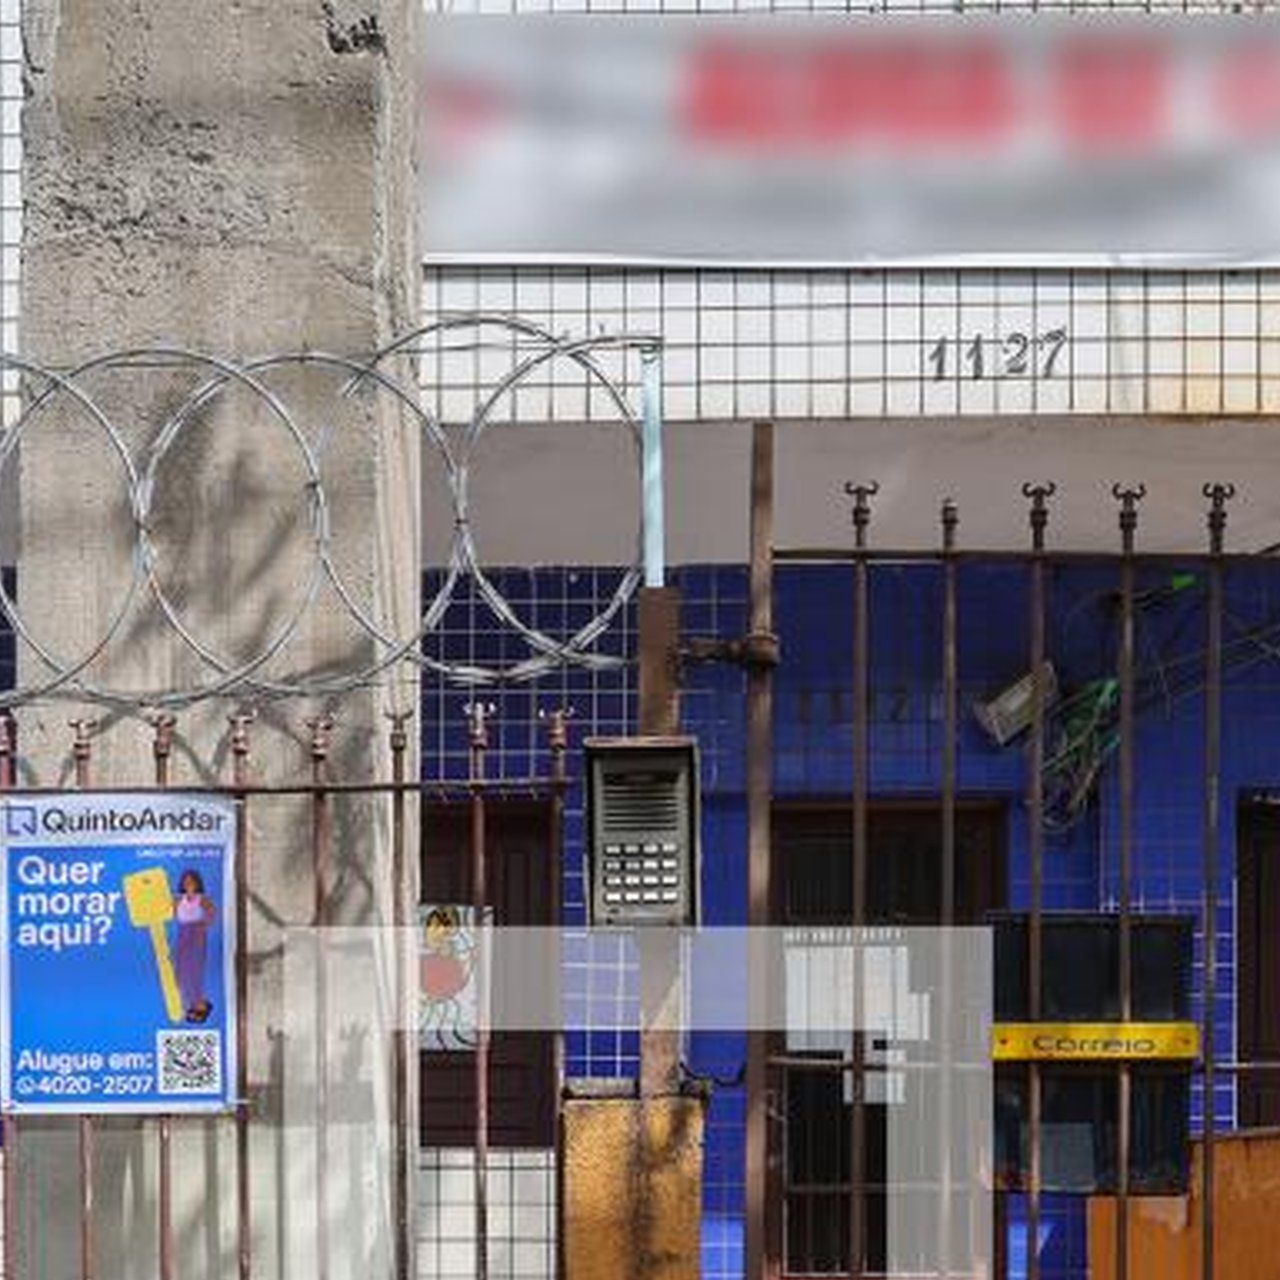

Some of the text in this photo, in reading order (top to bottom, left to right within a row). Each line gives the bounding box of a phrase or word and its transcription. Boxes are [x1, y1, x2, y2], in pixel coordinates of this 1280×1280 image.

[929, 330, 1067, 381] 1127
[42, 808, 226, 834] QuintoAndar
[18, 855, 105, 886] Quer
[19, 891, 121, 916] morar
[18, 916, 113, 951] aqui?
[1031, 1034, 1157, 1054] Correio
[17, 1050, 155, 1076] Alugue em:
[37, 1076, 153, 1095] 4020-2507
